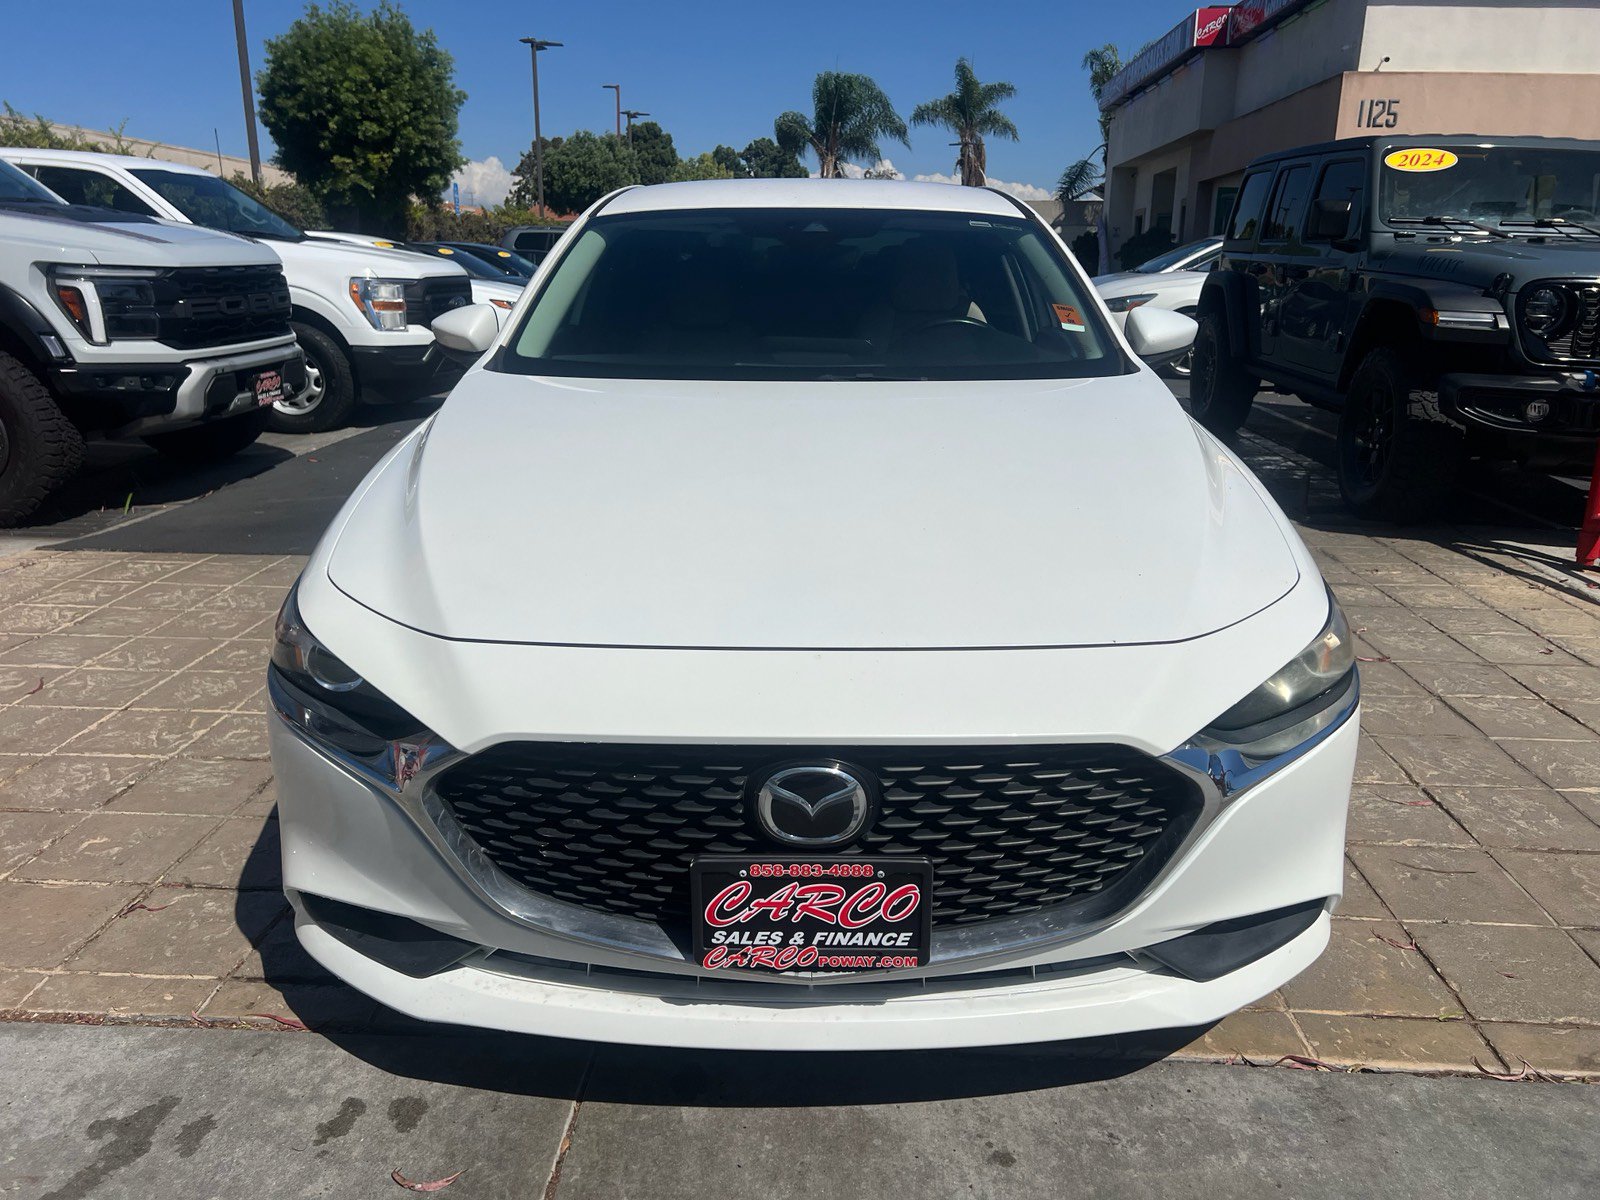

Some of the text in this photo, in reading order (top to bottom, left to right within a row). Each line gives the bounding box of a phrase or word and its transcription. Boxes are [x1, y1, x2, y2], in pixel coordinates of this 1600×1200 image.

[1357, 99, 1400, 128] 1125
[1397, 152, 1446, 167] 2024
[749, 863, 874, 878] 858-883-4888
[704, 880, 921, 929] CARCO
[711, 930, 914, 946] SALES & FINANCE
